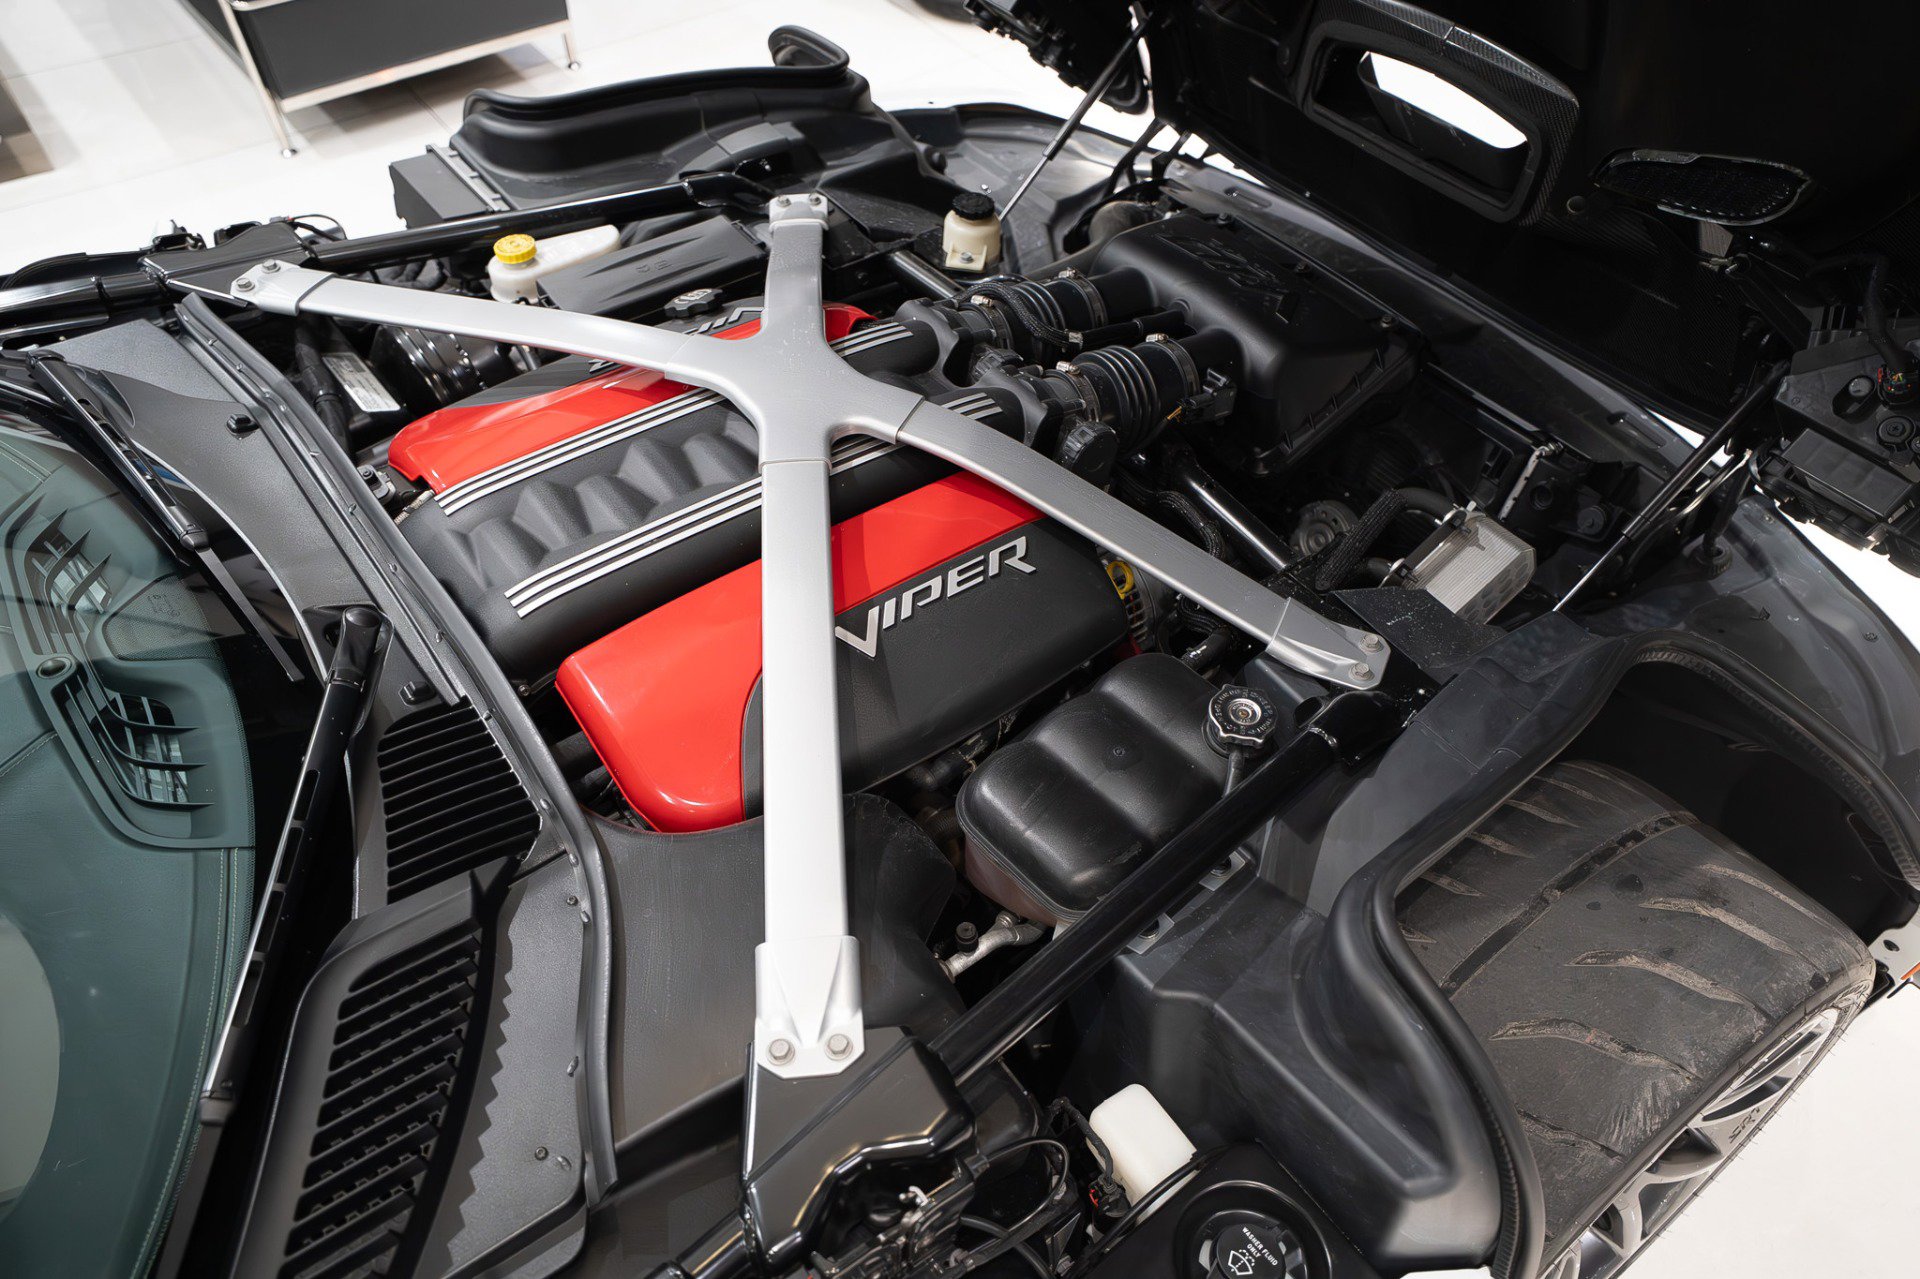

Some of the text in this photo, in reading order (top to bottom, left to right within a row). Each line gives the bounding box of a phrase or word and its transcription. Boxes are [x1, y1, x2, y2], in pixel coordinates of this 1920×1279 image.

[834, 535, 1037, 659] VIPER
[1242, 1226, 1279, 1266] WASHER FLUID
[1246, 1243, 1262, 1258] ONLY
